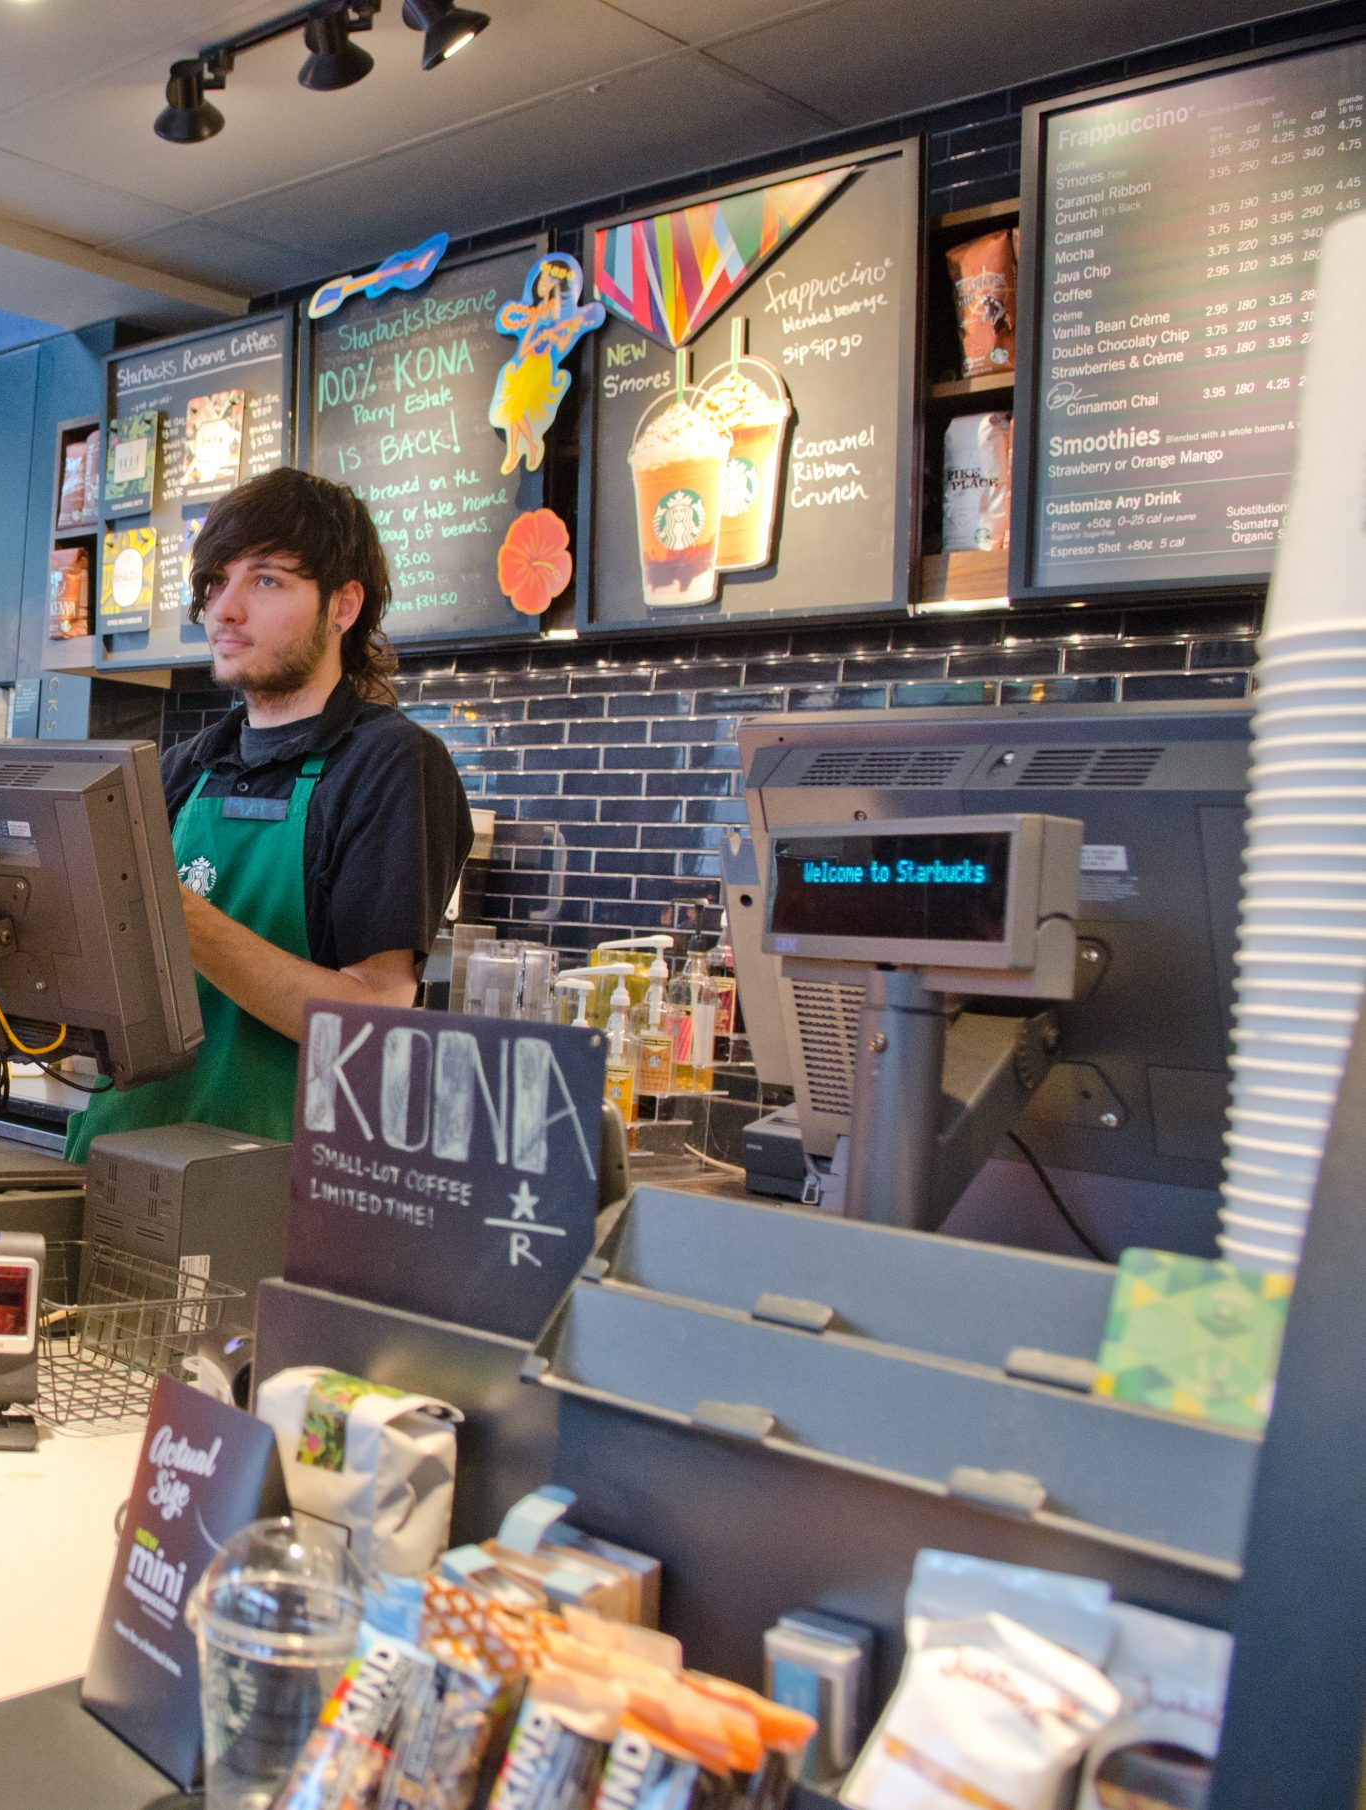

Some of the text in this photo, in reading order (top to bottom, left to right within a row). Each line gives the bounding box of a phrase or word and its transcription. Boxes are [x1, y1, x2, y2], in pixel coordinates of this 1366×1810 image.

[1056, 116, 1363, 191] S'mores 3.95 230 4.25 330 4.75
[1055, 138, 1362, 210] Caramel Ribbon 3.95 250 4.25 340 4.75
[1054, 176, 1361, 245] Caramel 3.75 190 3.95 300 4.45
[1055, 207, 1097, 225] Crunch
[1054, 198, 1361, 265] Mocha 3.75 190 3.95 290 4.45
[1053, 226, 1324, 285] Java Chip 3.75 220 3.95 340
[1053, 248, 1323, 304] Coffee 2.95 120 3.25 180
[782, 293, 888, 335] blended beverage
[1052, 310, 1083, 323] Crème
[1052, 293, 1293, 340] Vanilla Bean Crème 2.95 180 3.25
[606, 338, 647, 368] NEW
[1052, 344, 1094, 360] Double
[1097, 334, 1158, 354] Chocolaty
[1161, 328, 1190, 344] Chip
[1205, 324, 1228, 338] 3.75
[1236, 319, 1257, 333] 210
[1268, 313, 1293, 327] 3.95
[117, 359, 177, 388] Starbucks
[230, 330, 278, 358] Coffees
[317, 357, 377, 413] 100%
[393, 338, 475, 393] KONA
[1051, 360, 1126, 380] Strawberries
[1129, 355, 1140, 369] &
[1143, 351, 1184, 367] Crème
[1204, 344, 1227, 358] 3.75
[1235, 340, 1256, 354] 180
[1267, 335, 1292, 349] 3.95
[603, 369, 671, 399] S'mores
[1066, 377, 1291, 417] Cinnamon Chai 3.95 180 4.25
[352, 384, 454, 429] Parry Estate
[379, 410, 461, 466] BACK!
[792, 424, 875, 460] Caramel
[1048, 422, 1285, 458] Smoothies Blended with a whole banana
[792, 460, 861, 486] Ribbon
[947, 467, 981, 481] PIKE
[1047, 448, 1224, 478] Strawberry or Orange Mango
[370, 475, 420, 501] brewed
[429, 476, 447, 491] on
[453, 467, 480, 489] the
[790, 481, 869, 509] Crunch
[951, 477, 999, 491] PLACE
[1045, 489, 1183, 516] Customize Any Drink
[403, 506, 419, 522] or
[423, 500, 456, 521] take
[462, 488, 508, 513] home
[1146, 512, 1163, 524] cal
[415, 523, 434, 541] of
[1097, 541, 1121, 554] Shot
[1159, 538, 1168, 549] 5
[1169, 536, 1186, 549] cal
[1231, 530, 1274, 544] Organic
[393, 551, 431, 569] $5.00
[398, 570, 435, 589] $5.50
[415, 591, 458, 612] $34.50
[803, 858, 987, 885] Welcome to Starbucks
[303, 1010, 599, 1182] KONA
[311, 1143, 474, 1208] SMALL-LOT COFFEE
[309, 1177, 382, 1216] LIMITED
[509, 1232, 543, 1268] R
[148, 1424, 223, 1478] Actual
[147, 1467, 191, 1522] Size
[128, 1543, 187, 1605] mini
[334, 1643, 401, 1734] KIND
[501, 1710, 554, 1810] KIND
